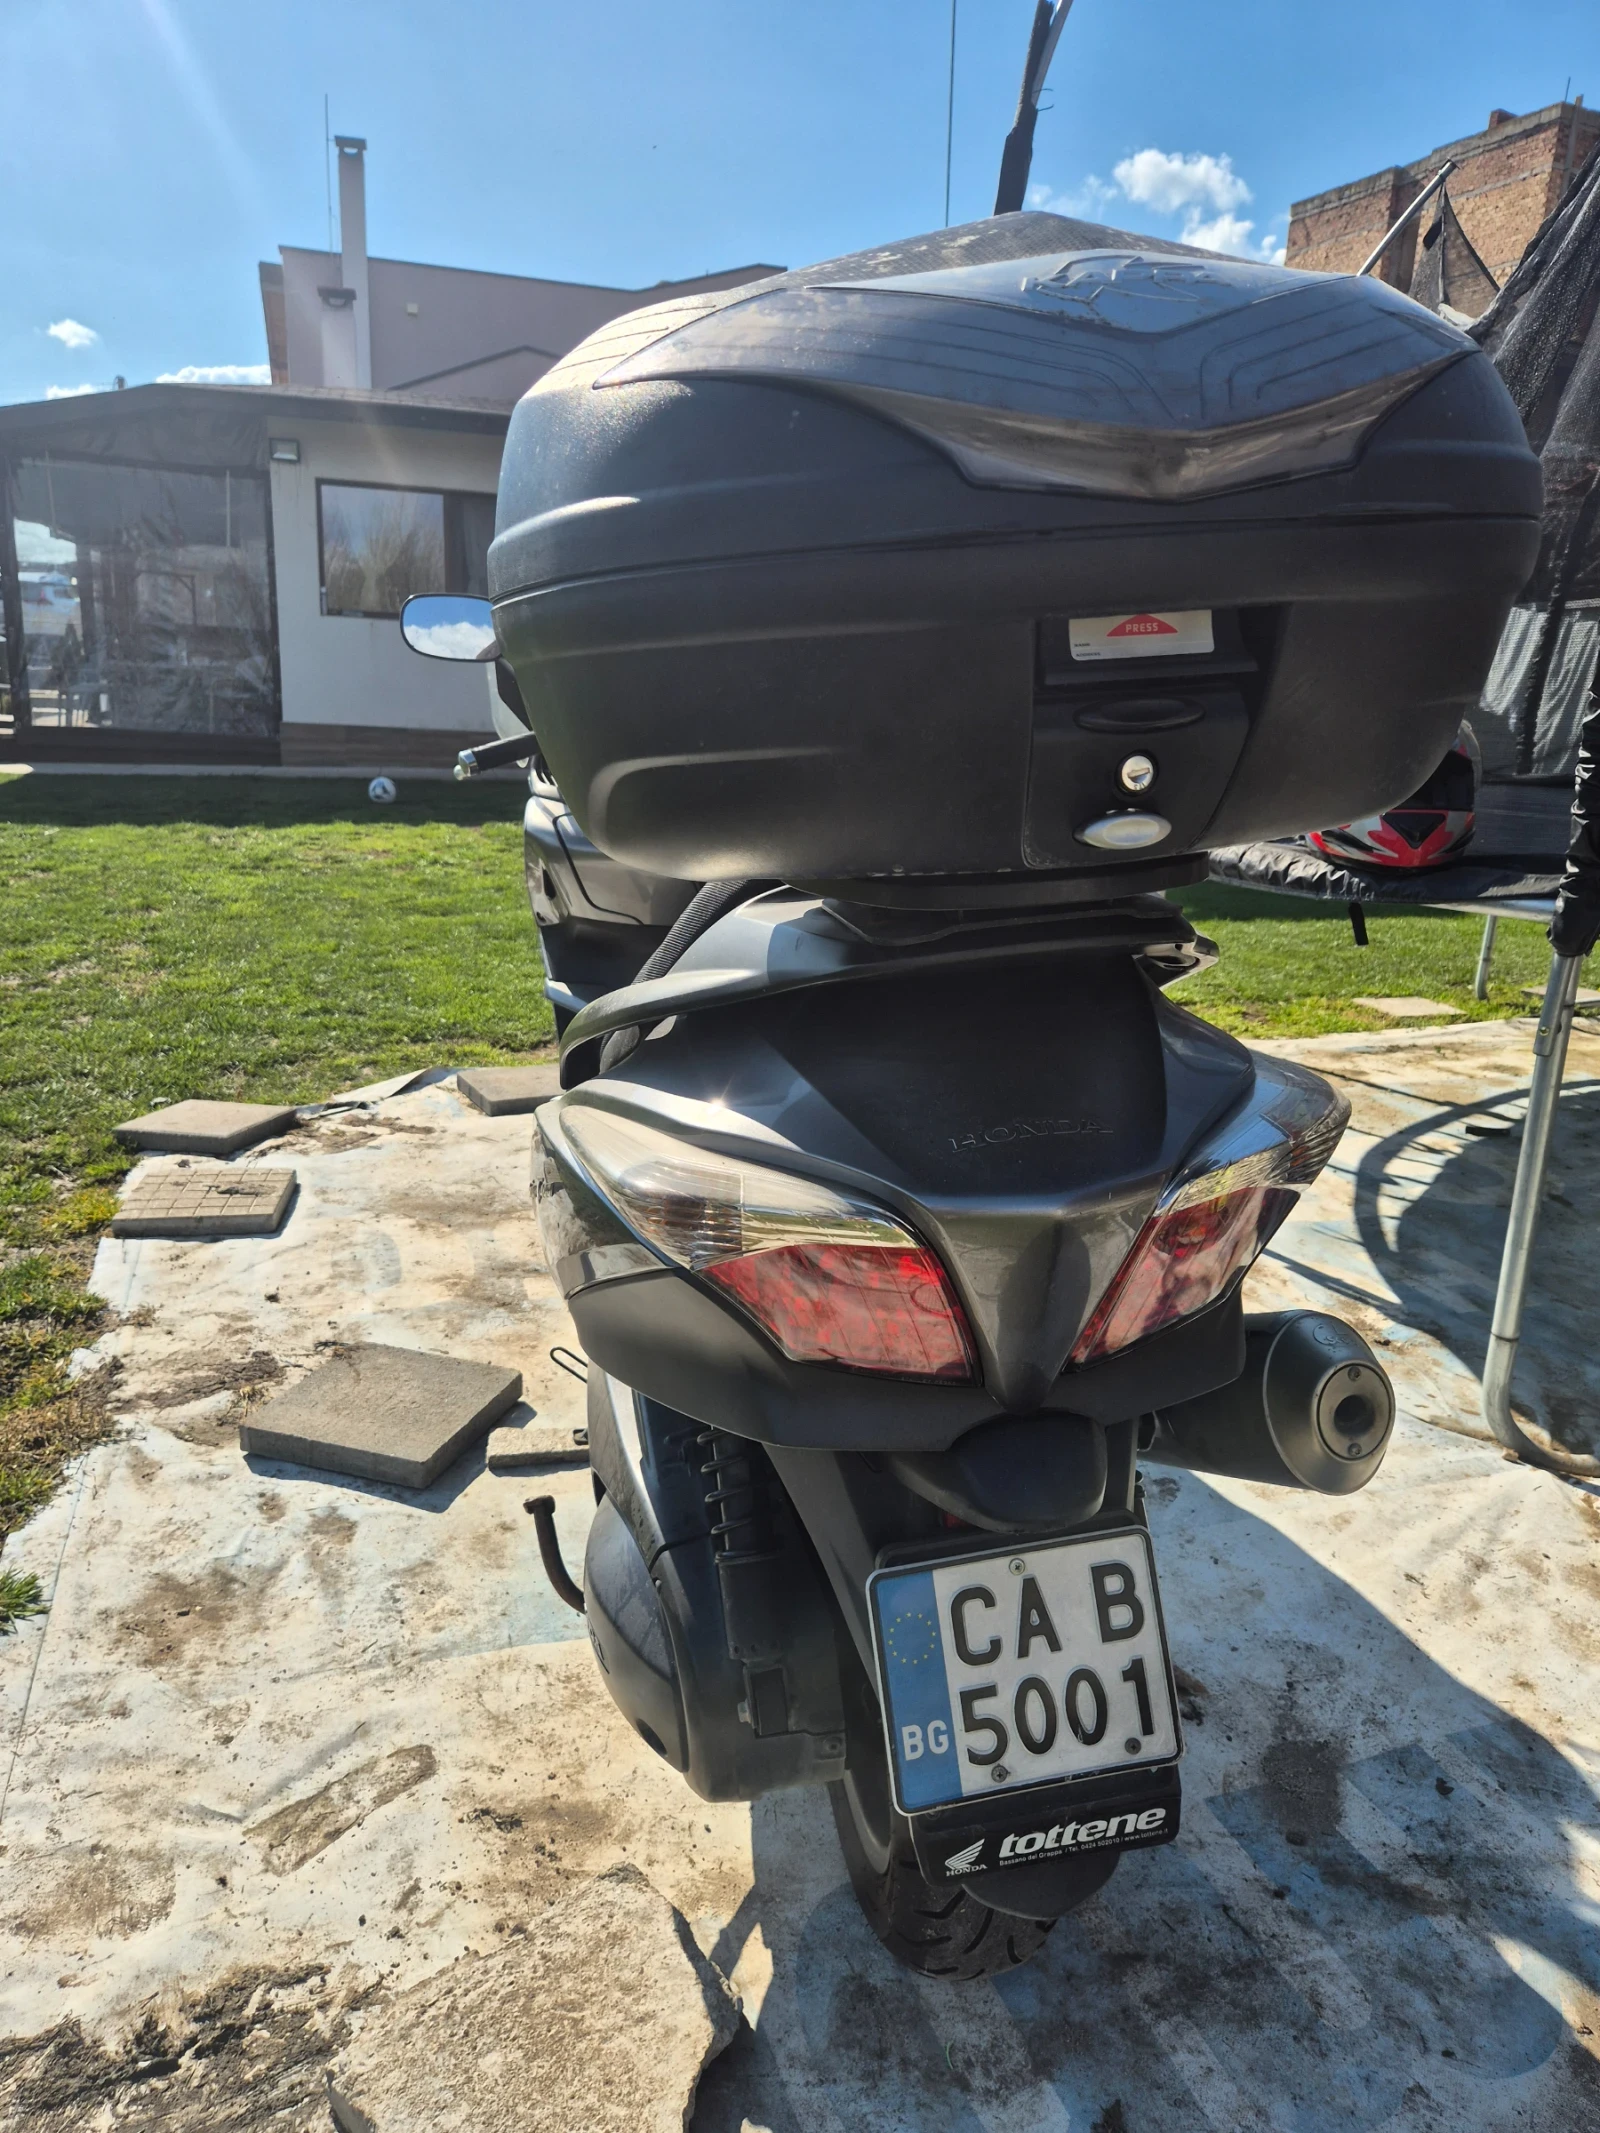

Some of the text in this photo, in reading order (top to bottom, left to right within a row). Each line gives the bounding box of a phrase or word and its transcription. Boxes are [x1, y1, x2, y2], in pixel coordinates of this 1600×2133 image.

[1125, 622, 1159, 633] PRESS
[948, 1118, 1114, 1153] HONDA
[950, 1561, 1145, 1667] CA B
[959, 1657, 1154, 1766] 5001
[901, 1719, 949, 1761] BG
[999, 1807, 1167, 1858] tottene
[945, 1862, 988, 1877] HONDA
[999, 1856, 1027, 1867] Bassano
[1027, 1853, 1038, 1861] del
[1038, 1848, 1063, 1859] Grappa
[1080, 1841, 1097, 1850] 0424
[1097, 1837, 1120, 1847] 502010
